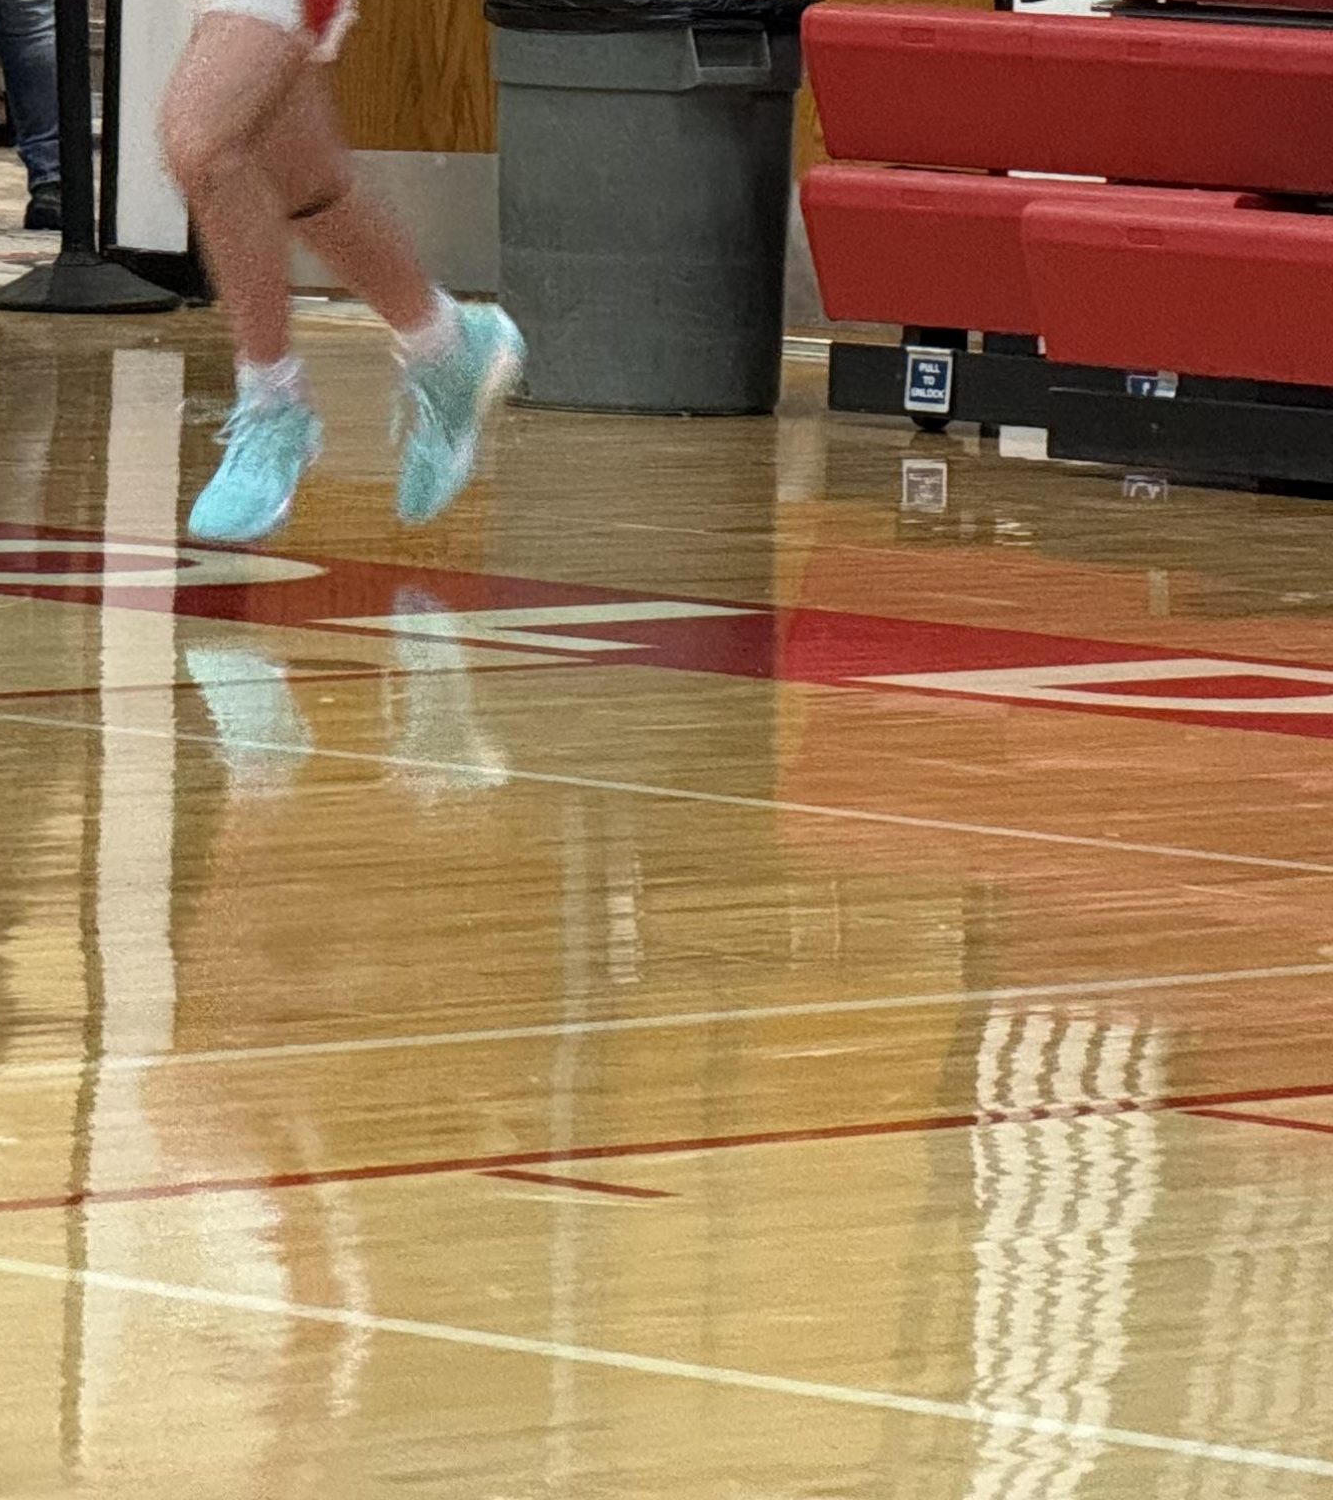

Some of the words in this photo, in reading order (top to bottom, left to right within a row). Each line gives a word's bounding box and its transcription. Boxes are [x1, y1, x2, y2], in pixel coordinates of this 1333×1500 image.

[918, 361, 941, 374] PULL
[922, 375, 936, 386] TO
[910, 386, 946, 399] UNLOCK
